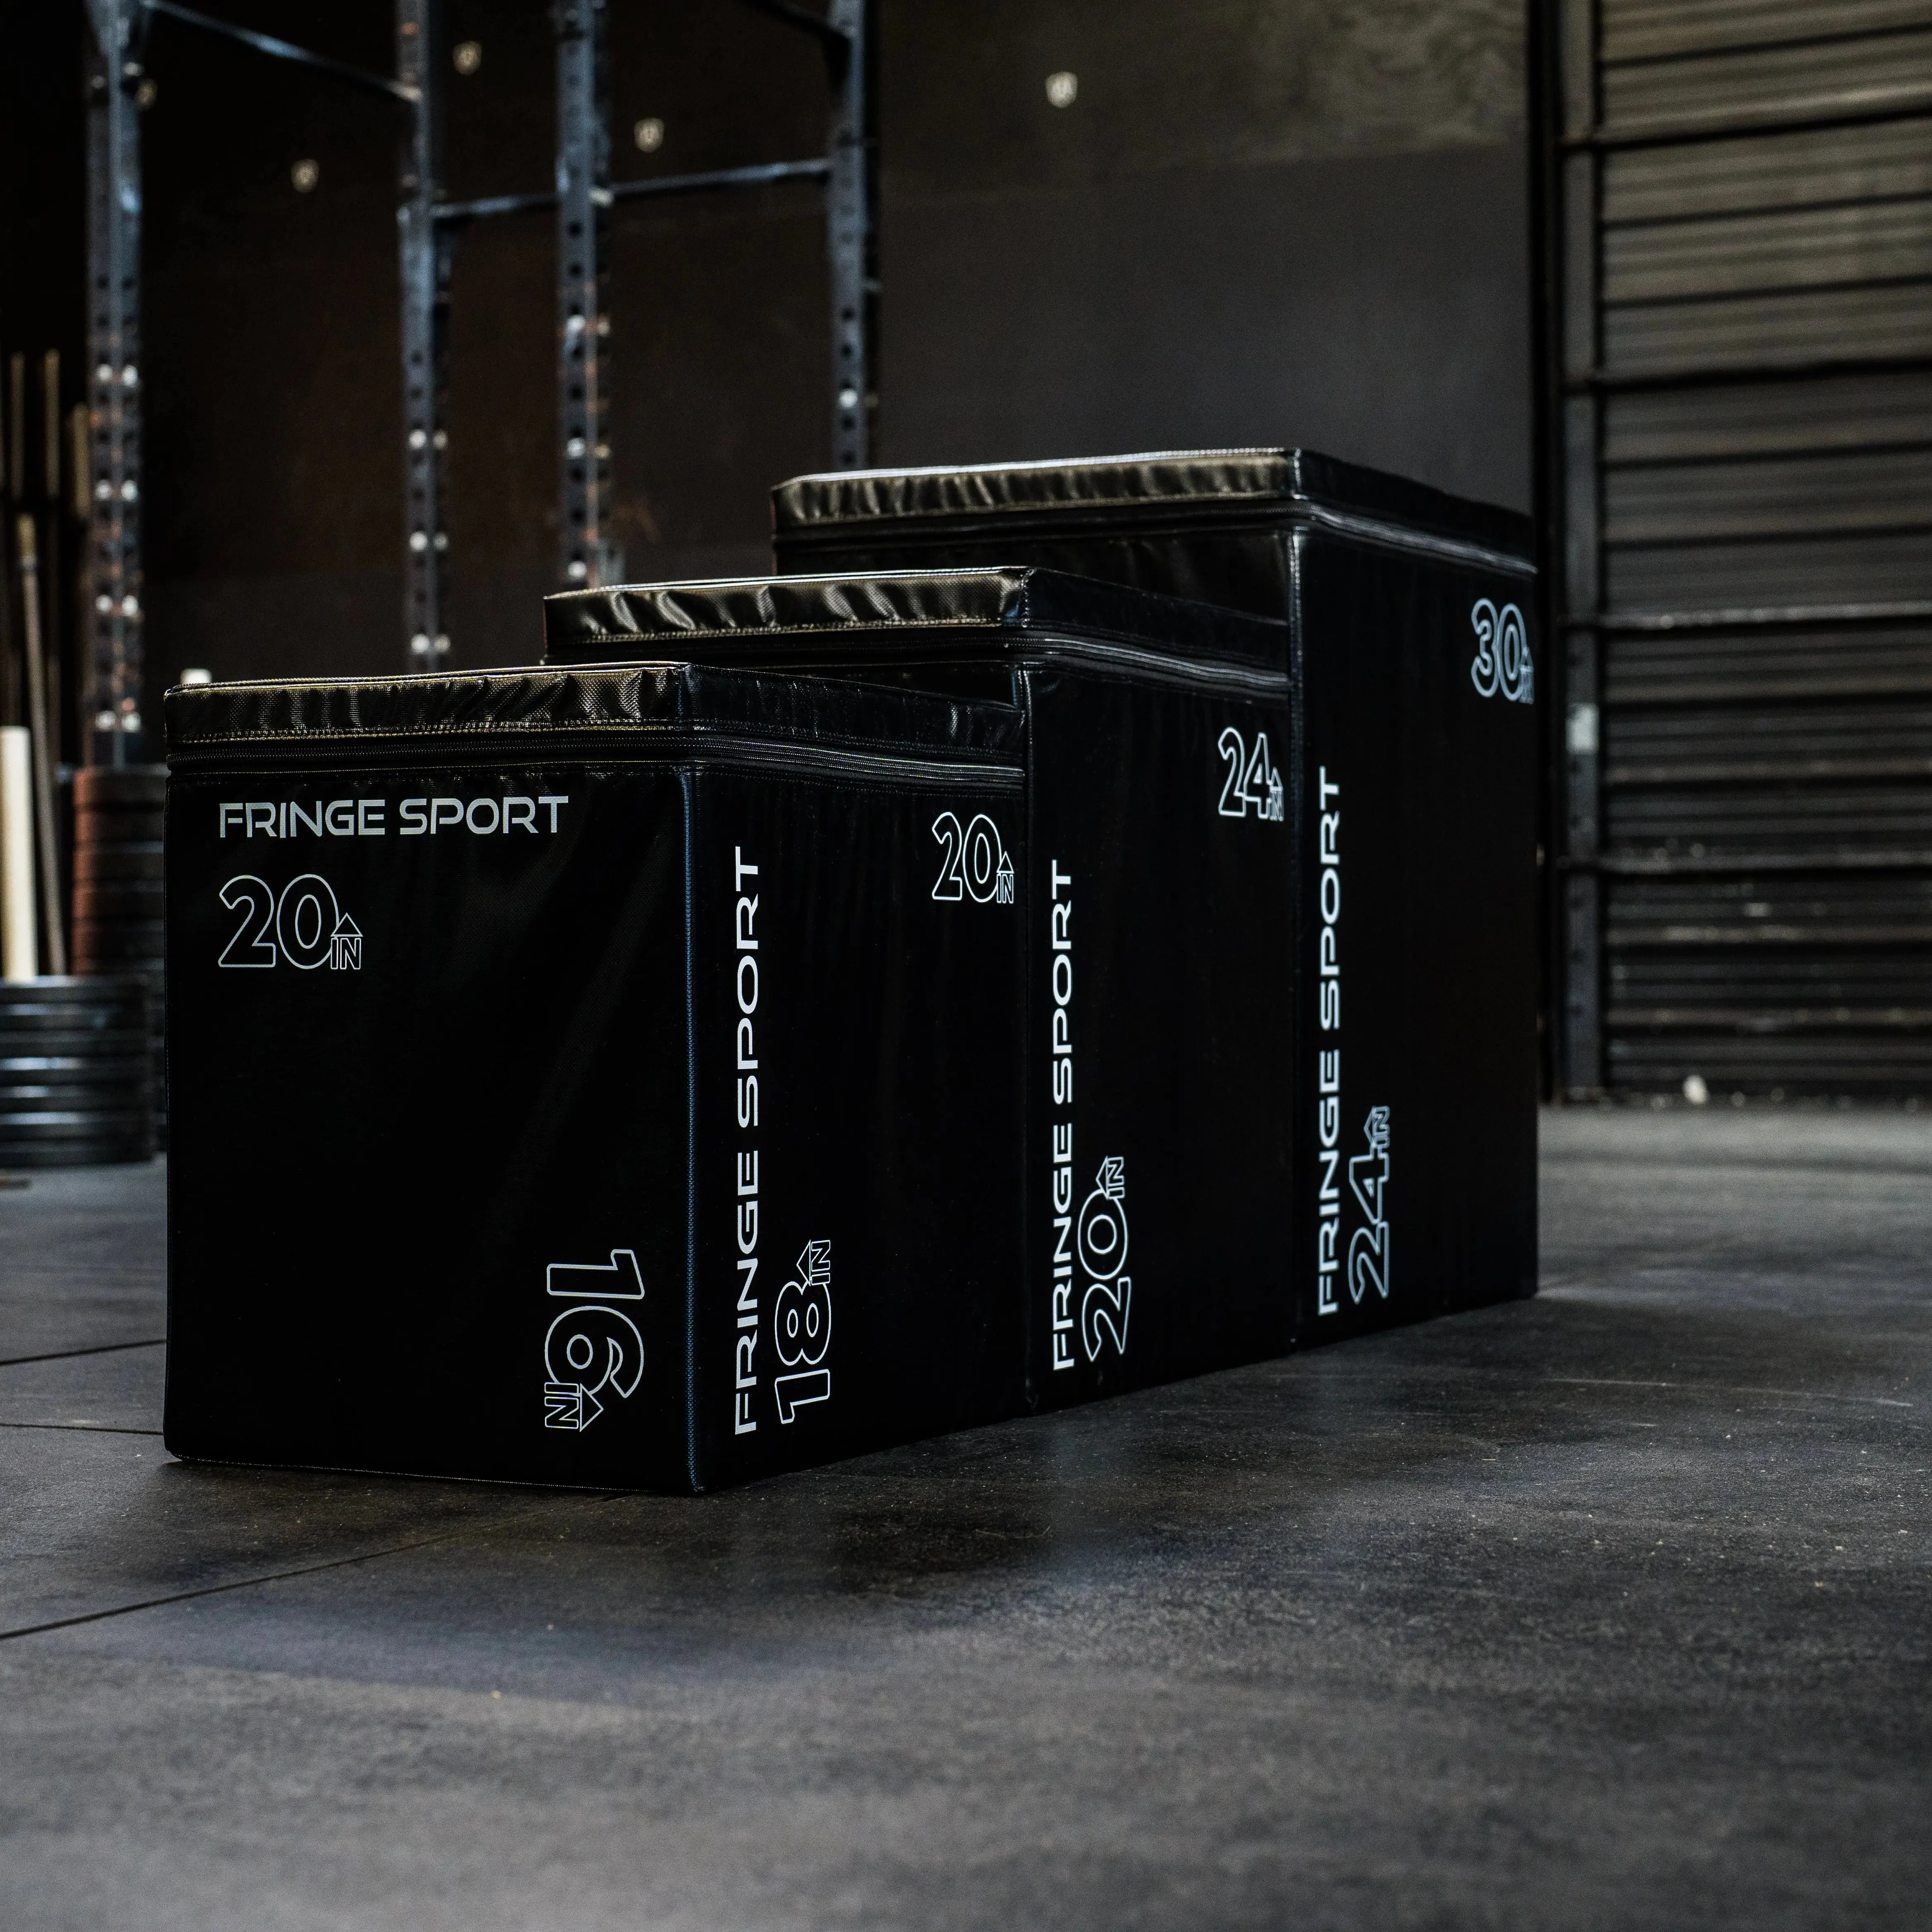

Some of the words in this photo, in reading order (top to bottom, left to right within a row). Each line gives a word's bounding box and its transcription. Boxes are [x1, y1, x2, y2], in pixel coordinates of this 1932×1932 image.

[1471, 598, 1527, 701] 30
[220, 799, 385, 838] FRINGE
[399, 795, 569, 835] SPORT
[932, 812, 1002, 903] 20
[997, 873, 1014, 904] IN
[1218, 727, 1271, 819] 24
[218, 874, 339, 969] 20
[331, 937, 361, 970] IN
[1052, 859, 1072, 1105] SPORT
[1319, 766, 1339, 1030] SPORT
[735, 846, 758, 1128] SPORT
[1053, 1123, 1074, 1370] FRINGE
[1078, 1189, 1131, 1362] 20
[1107, 1156, 1125, 1199] IN
[1318, 1049, 1339, 1315] FRINGE
[1348, 1145, 1390, 1304] 24
[545, 1249, 645, 1398] 16
[735, 1150, 758, 1435] FRINGE
[775, 1281, 831, 1424] 18
[811, 1240, 831, 1286] IN
[544, 1382, 579, 1430] IN
